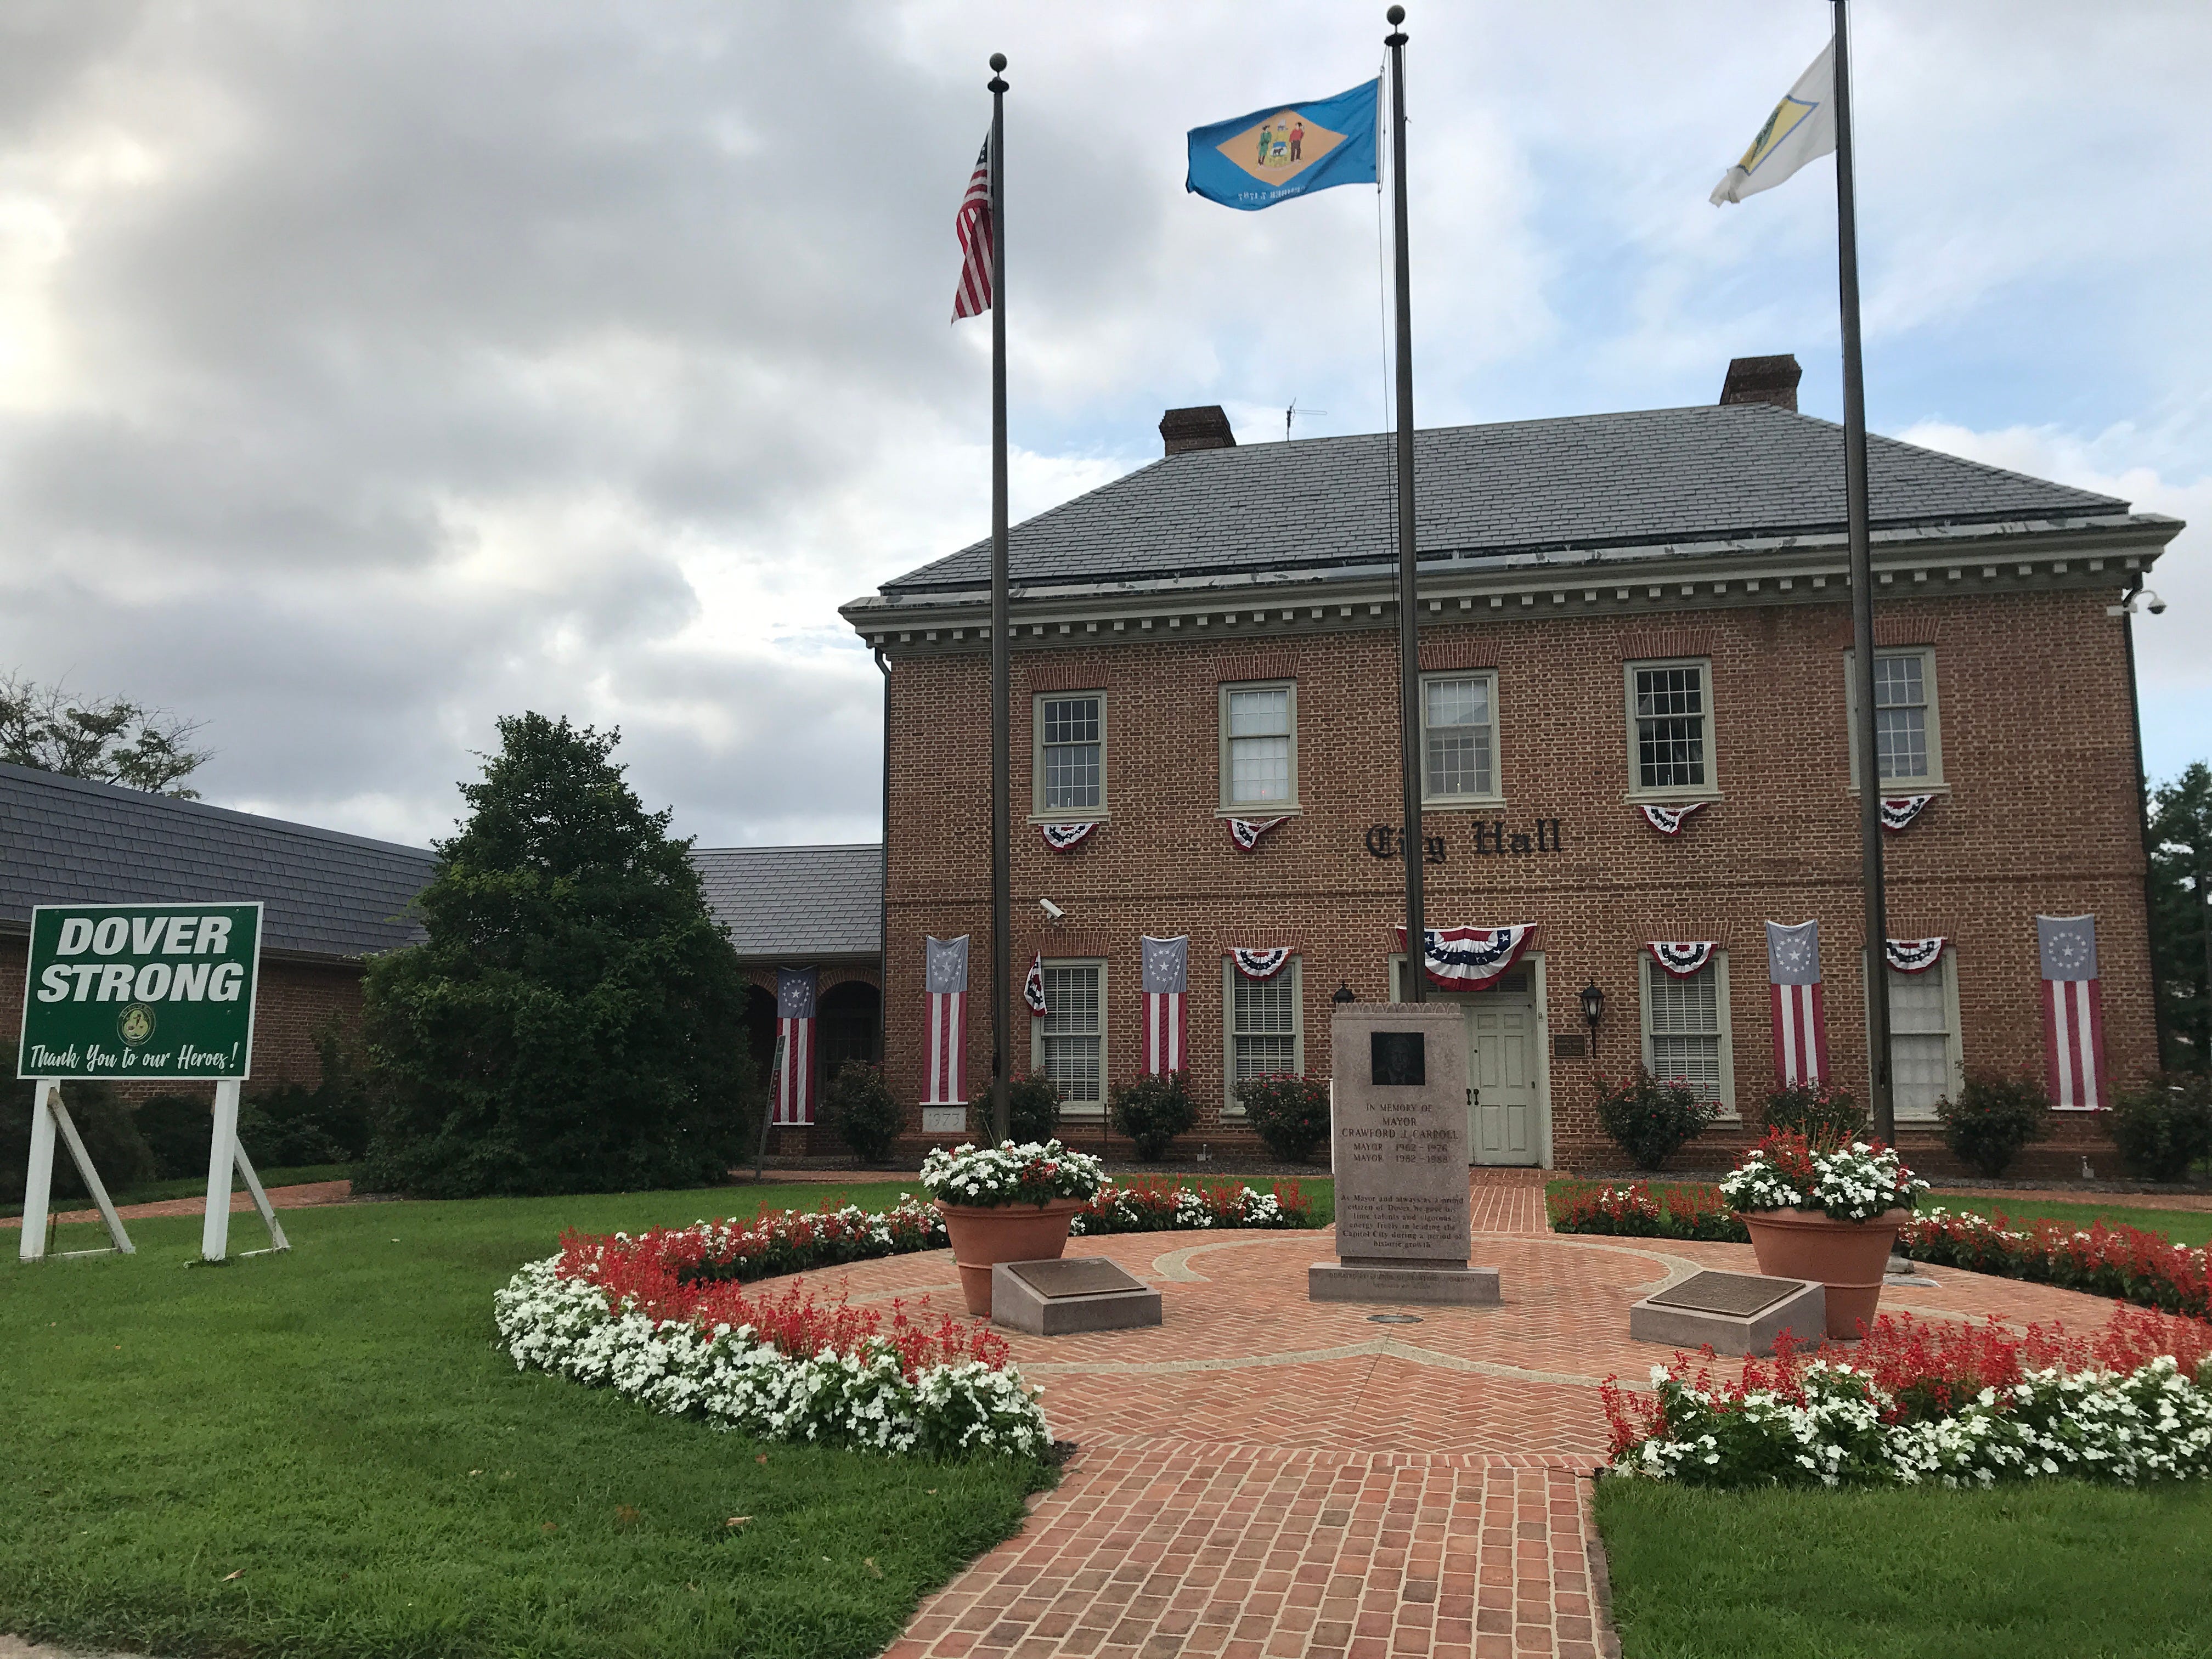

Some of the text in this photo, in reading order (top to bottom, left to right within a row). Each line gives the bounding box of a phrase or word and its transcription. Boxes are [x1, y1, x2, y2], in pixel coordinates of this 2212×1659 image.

[1365, 818, 1565, 865] Ciy Hall
[56, 916, 233, 956] DOVER
[37, 962, 244, 1002] STRONG
[30, 1041, 239, 1072] Thank You to our Heroes!
[1366, 1103, 1433, 1113] IN MEMORY OF
[1382, 1117, 1417, 1126] MAYOR
[1342, 1128, 1396, 1138] CRAWFORD
[1412, 1130, 1458, 1139] CARROLL
[1353, 1143, 1383, 1151] MAYOR
[1427, 1144, 1448, 1153] 1976
[1353, 1154, 1384, 1163] MAYOR
[1396, 1154, 1416, 1163] 1982
[1373, 1231, 1388, 1239] City
[1392, 1232, 1417, 1240] during
